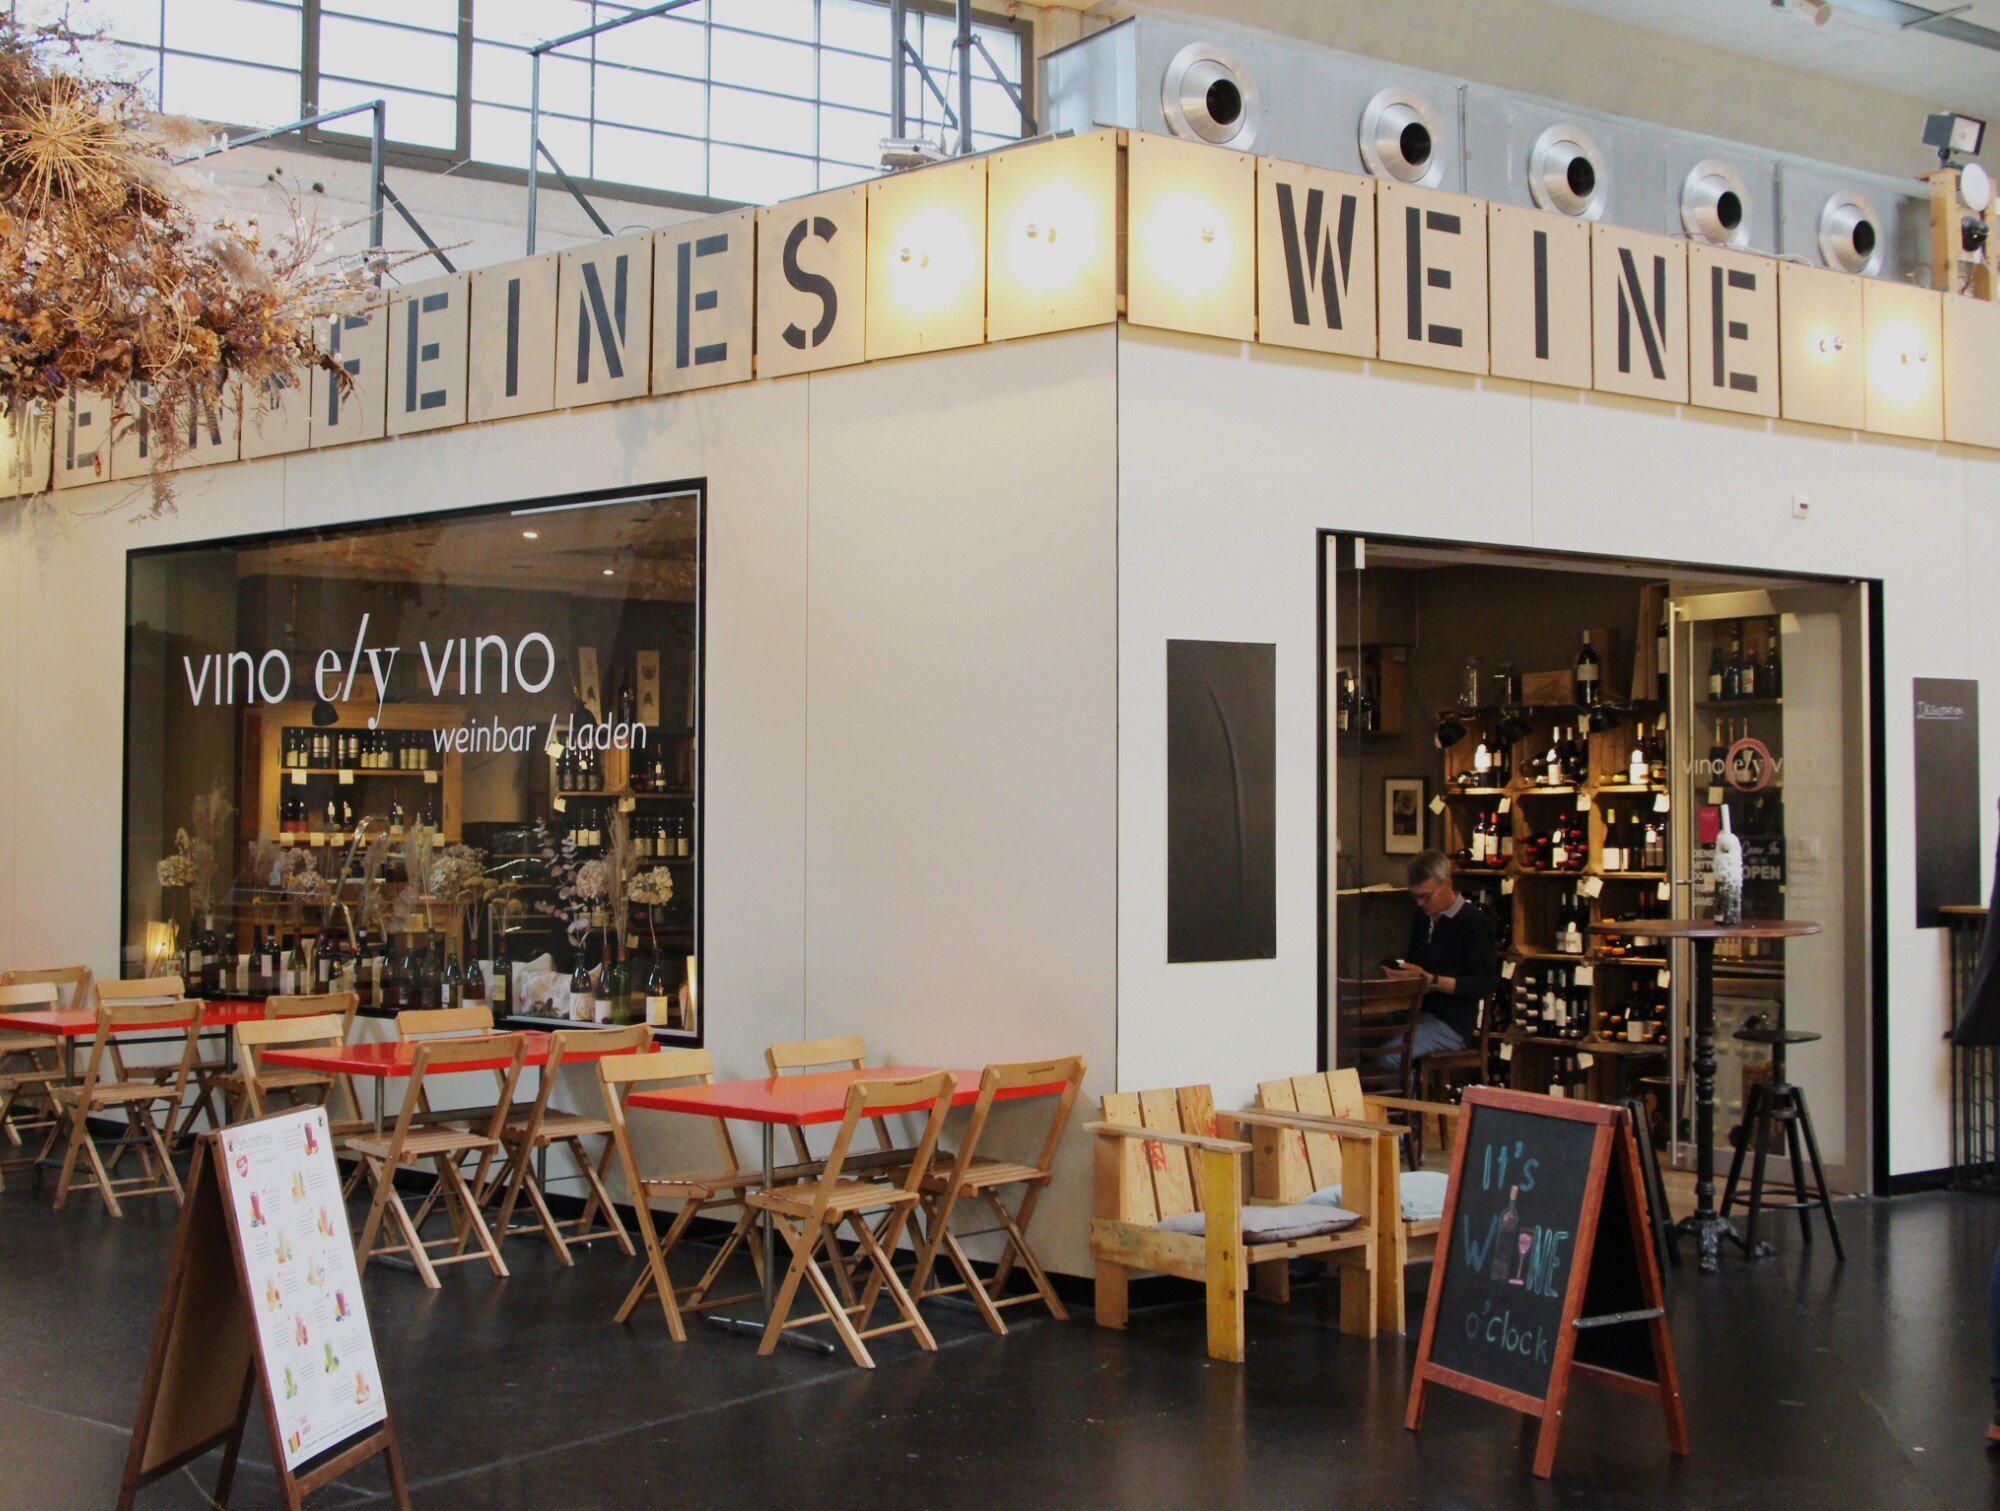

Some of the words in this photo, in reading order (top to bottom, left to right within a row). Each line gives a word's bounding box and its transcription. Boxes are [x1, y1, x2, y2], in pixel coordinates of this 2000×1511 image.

[1275, 182, 1758, 393] WEINE
[328, 216, 838, 426] FEINES
[183, 648, 291, 706] vino
[419, 631, 556, 697] vino
[432, 715, 537, 753] weinbar
[566, 711, 648, 753] laden
[1742, 865, 1781, 880] OPEN
[1483, 1141, 1539, 1192] It's
[1465, 1300, 1548, 1363] o'clock
